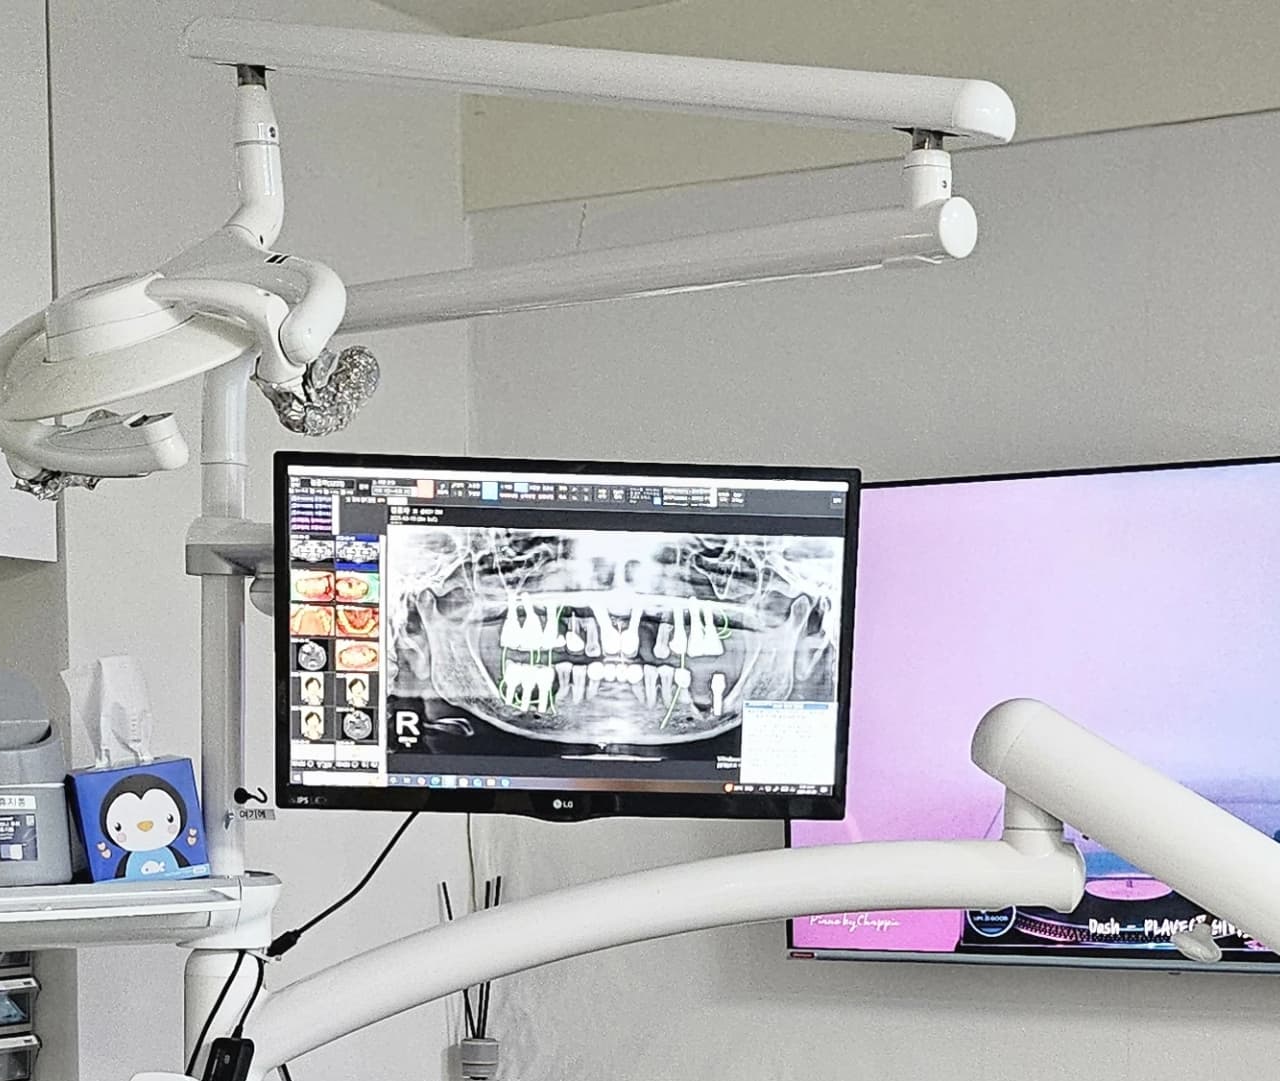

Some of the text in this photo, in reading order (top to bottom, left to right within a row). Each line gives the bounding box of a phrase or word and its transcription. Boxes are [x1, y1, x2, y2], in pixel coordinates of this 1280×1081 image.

[396, 711, 420, 736] R
[0, 798, 26, 808] 휴지통
[1088, 917, 1120, 936] Dash
